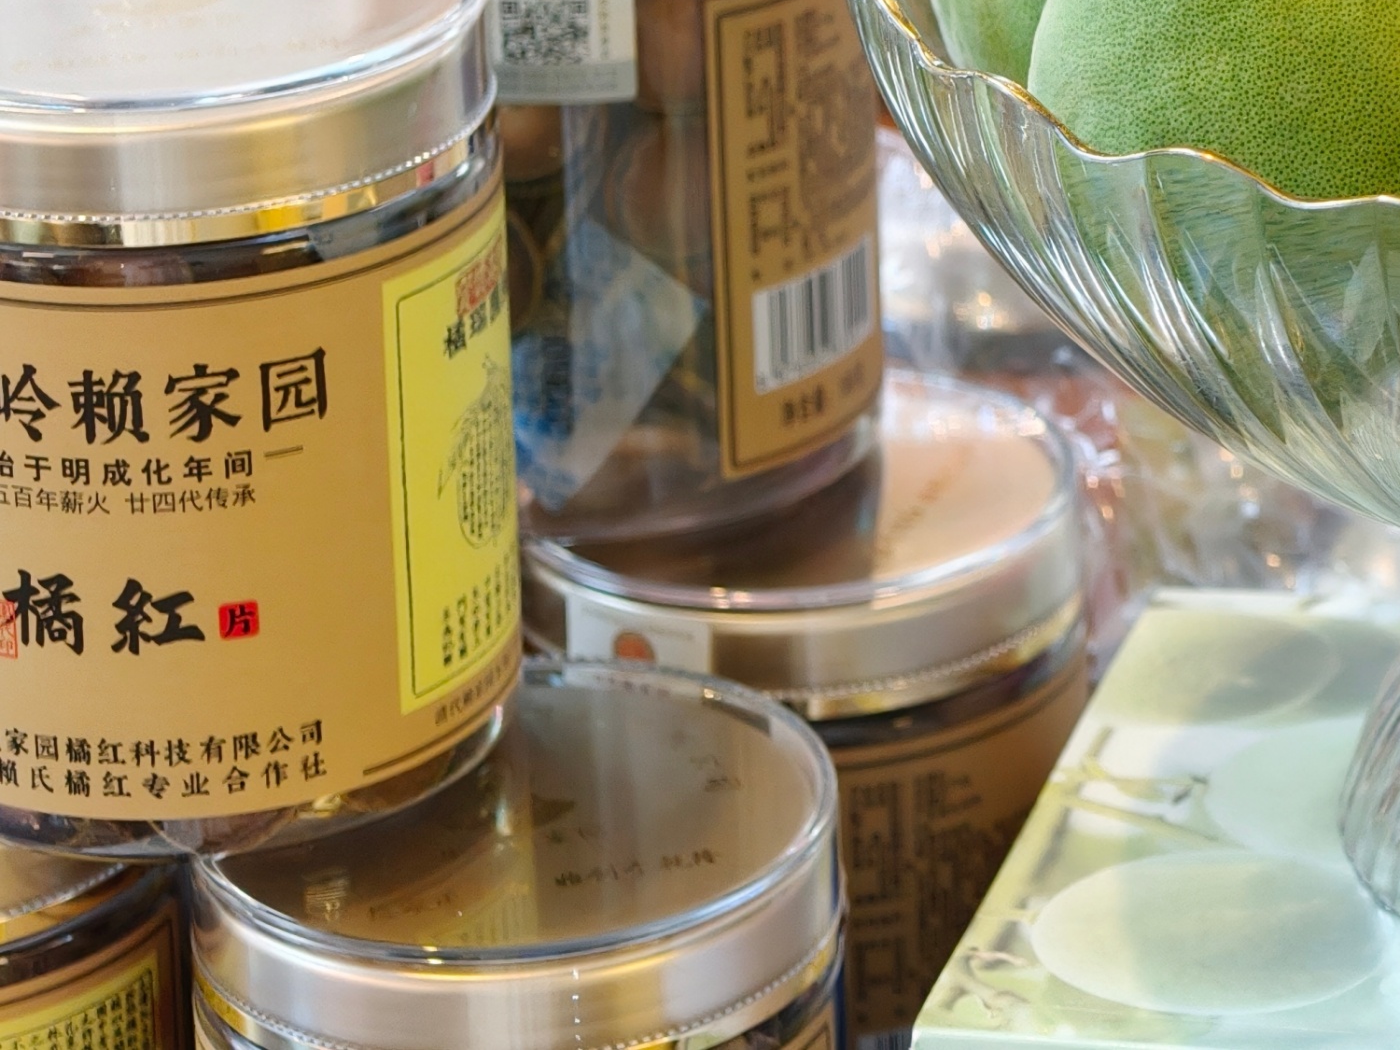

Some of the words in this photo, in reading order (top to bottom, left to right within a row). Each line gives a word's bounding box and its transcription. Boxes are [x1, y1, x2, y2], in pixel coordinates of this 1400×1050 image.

[125, 482, 256, 515] 廿四代传承
[224, 604, 256, 638] 片
